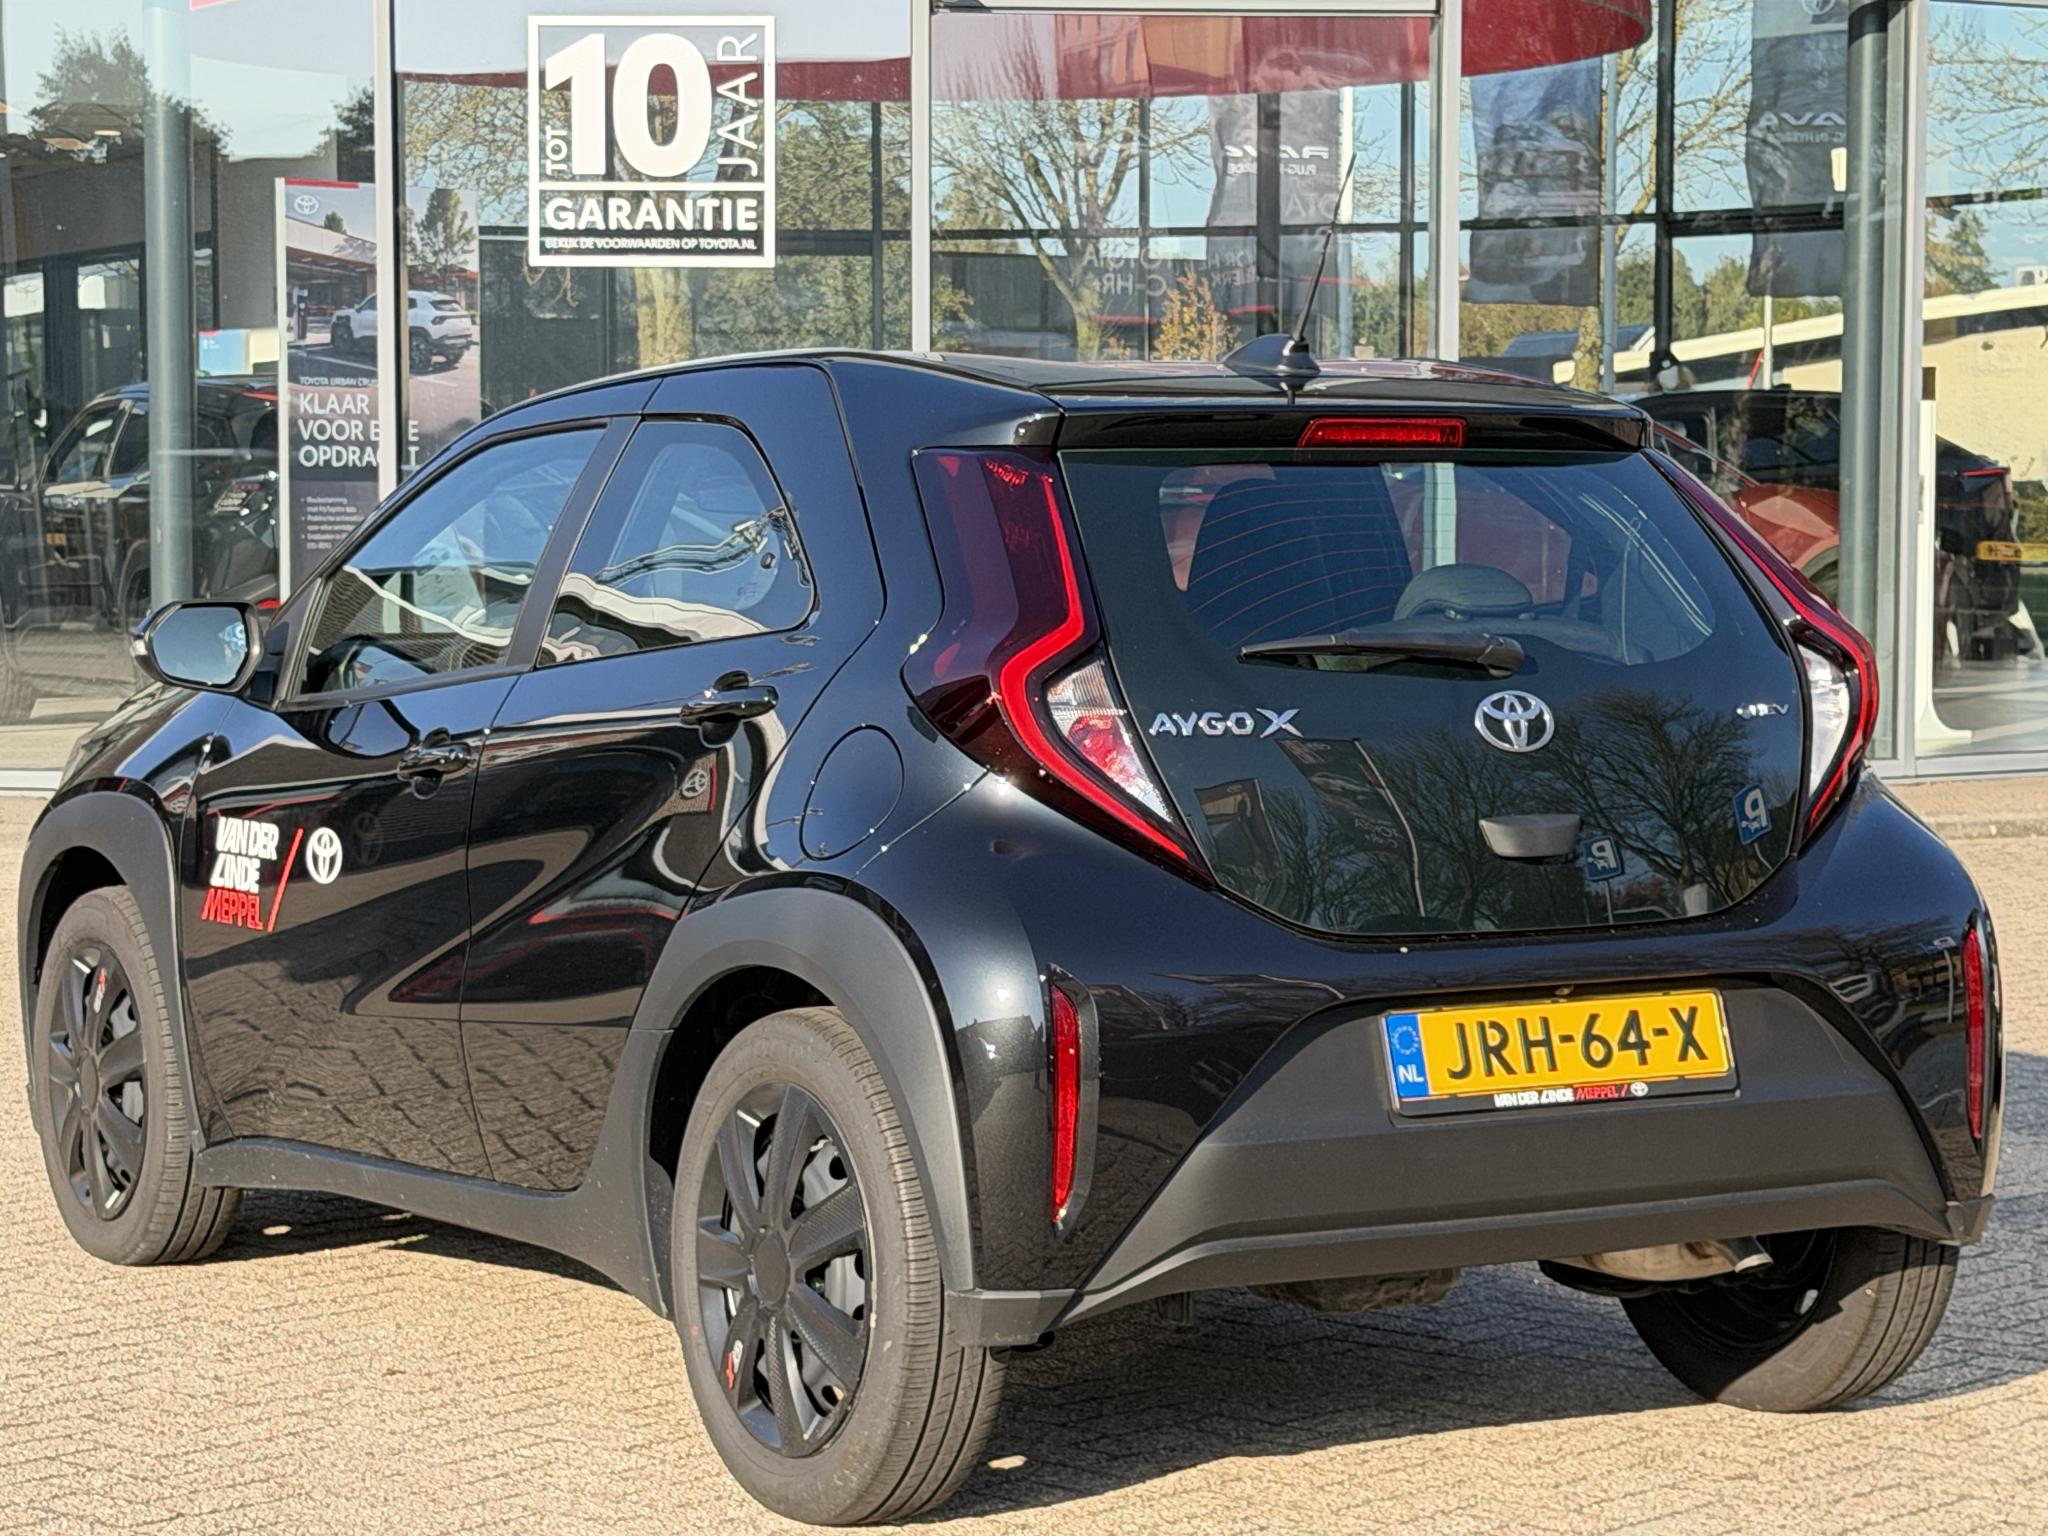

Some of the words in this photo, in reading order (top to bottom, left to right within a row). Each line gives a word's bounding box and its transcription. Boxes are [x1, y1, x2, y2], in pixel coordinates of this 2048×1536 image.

[545, 33, 713, 178] 10
[716, 33, 758, 177] JAAR
[546, 125, 567, 176] TOT
[545, 197, 758, 232] GARANTIE
[545, 237, 579, 249] BEKIJK
[581, 237, 595, 249] DE
[597, 238, 680, 249] VOORWAARDEN
[681, 239, 697, 250] OP
[699, 239, 758, 250] TOYOTA.NL
[300, 376, 328, 385] TOYOTA
[301, 393, 370, 415] KLAAR
[298, 419, 365, 442] VOOR
[299, 446, 420, 468] OPDRAT
[1149, 711, 1256, 737] AYGO
[1256, 707, 1305, 739] X
[209, 852, 261, 894] LINDE
[201, 887, 264, 930] MEPPEL
[1446, 1005, 1709, 1081] JRH-64-X
[1398, 1064, 1424, 1084] NL
[1540, 1087, 1575, 1105] LINDE
[1576, 1085, 1619, 1100] MEPPEL
